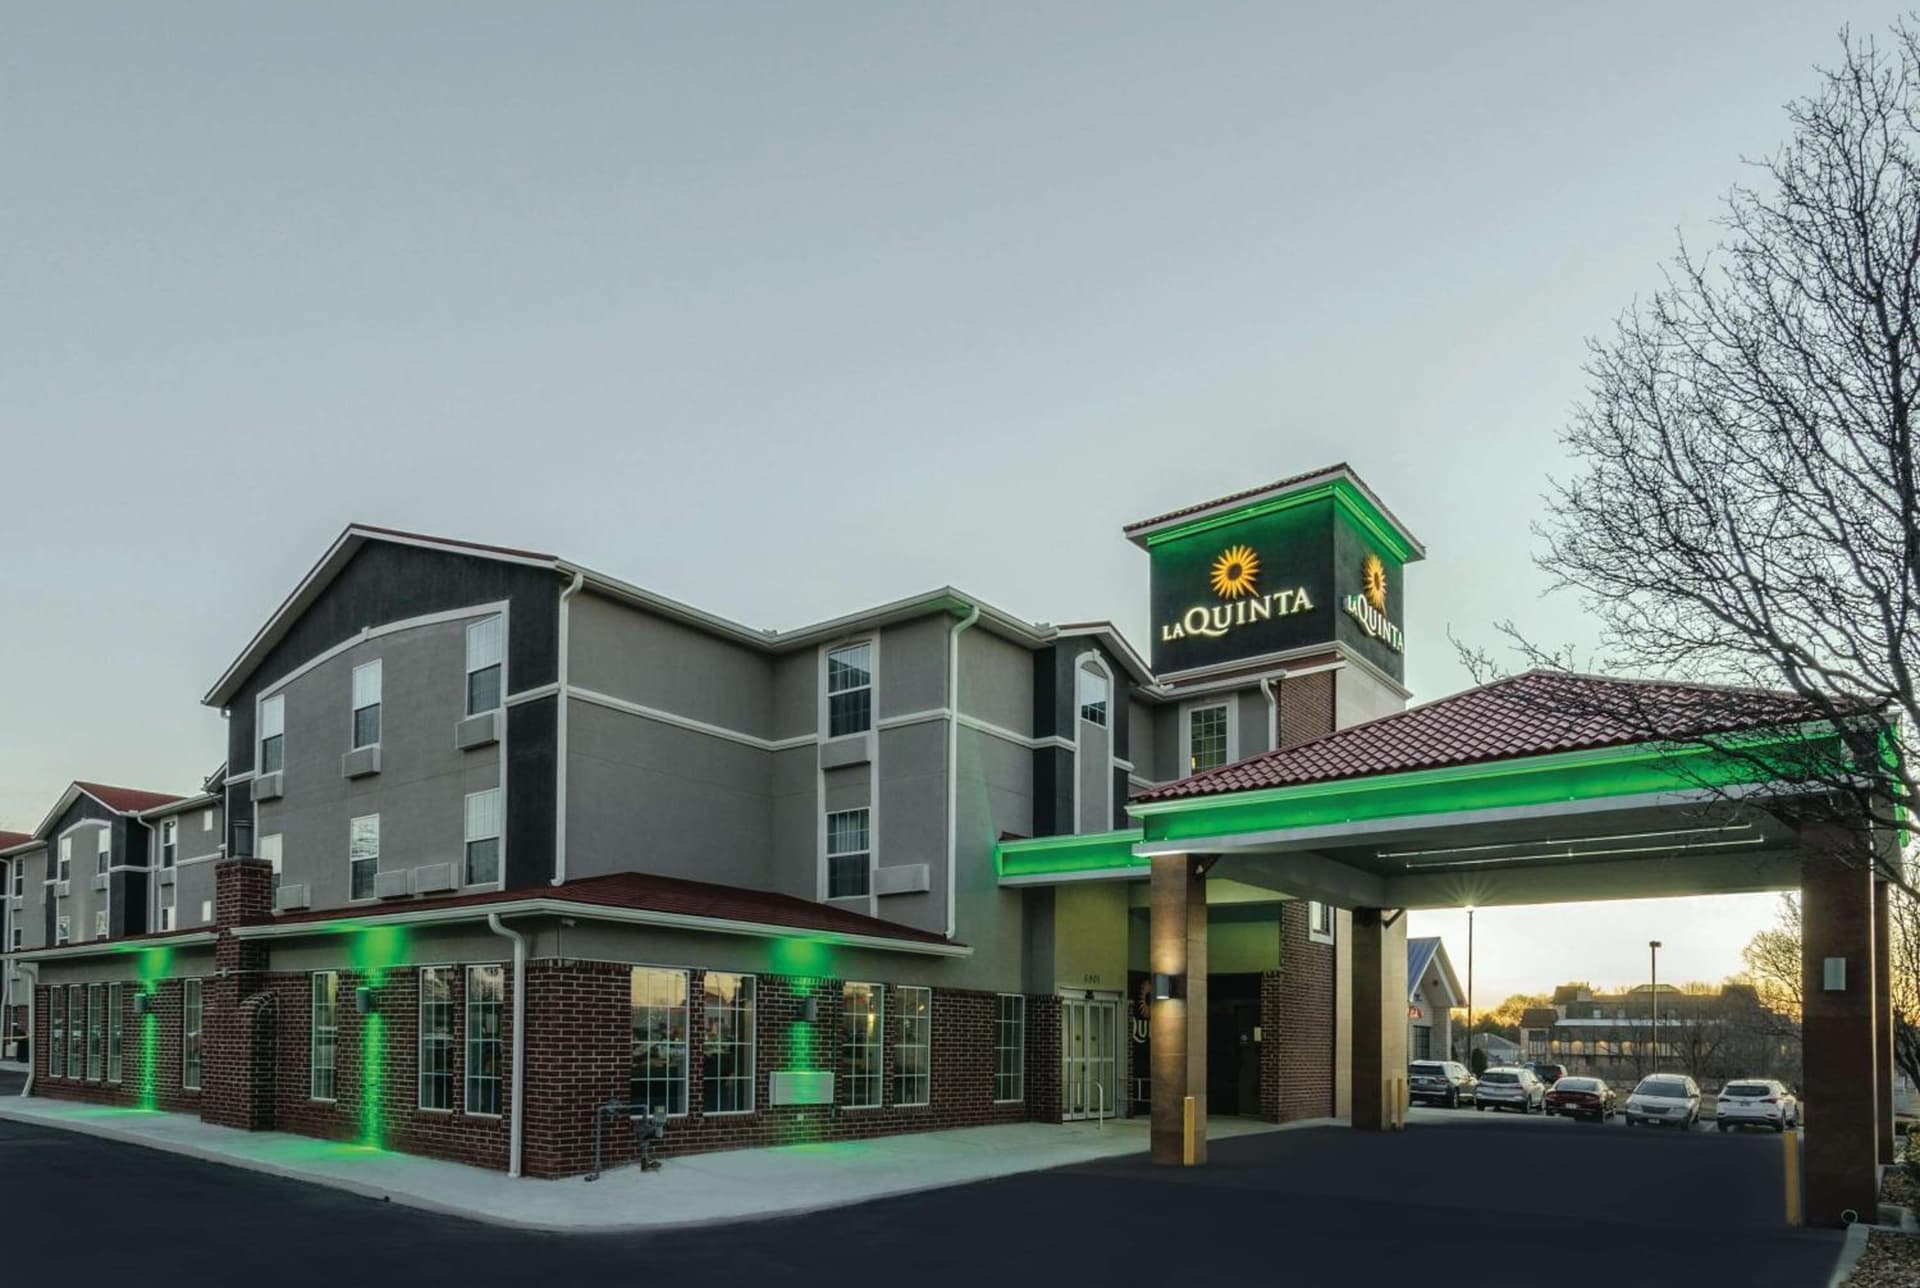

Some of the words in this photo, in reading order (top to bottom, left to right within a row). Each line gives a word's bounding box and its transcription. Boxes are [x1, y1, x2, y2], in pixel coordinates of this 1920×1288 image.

[1162, 622, 1185, 641] LA
[1184, 586, 1315, 637] QUINTA
[1358, 593, 1404, 654] QUINTA
